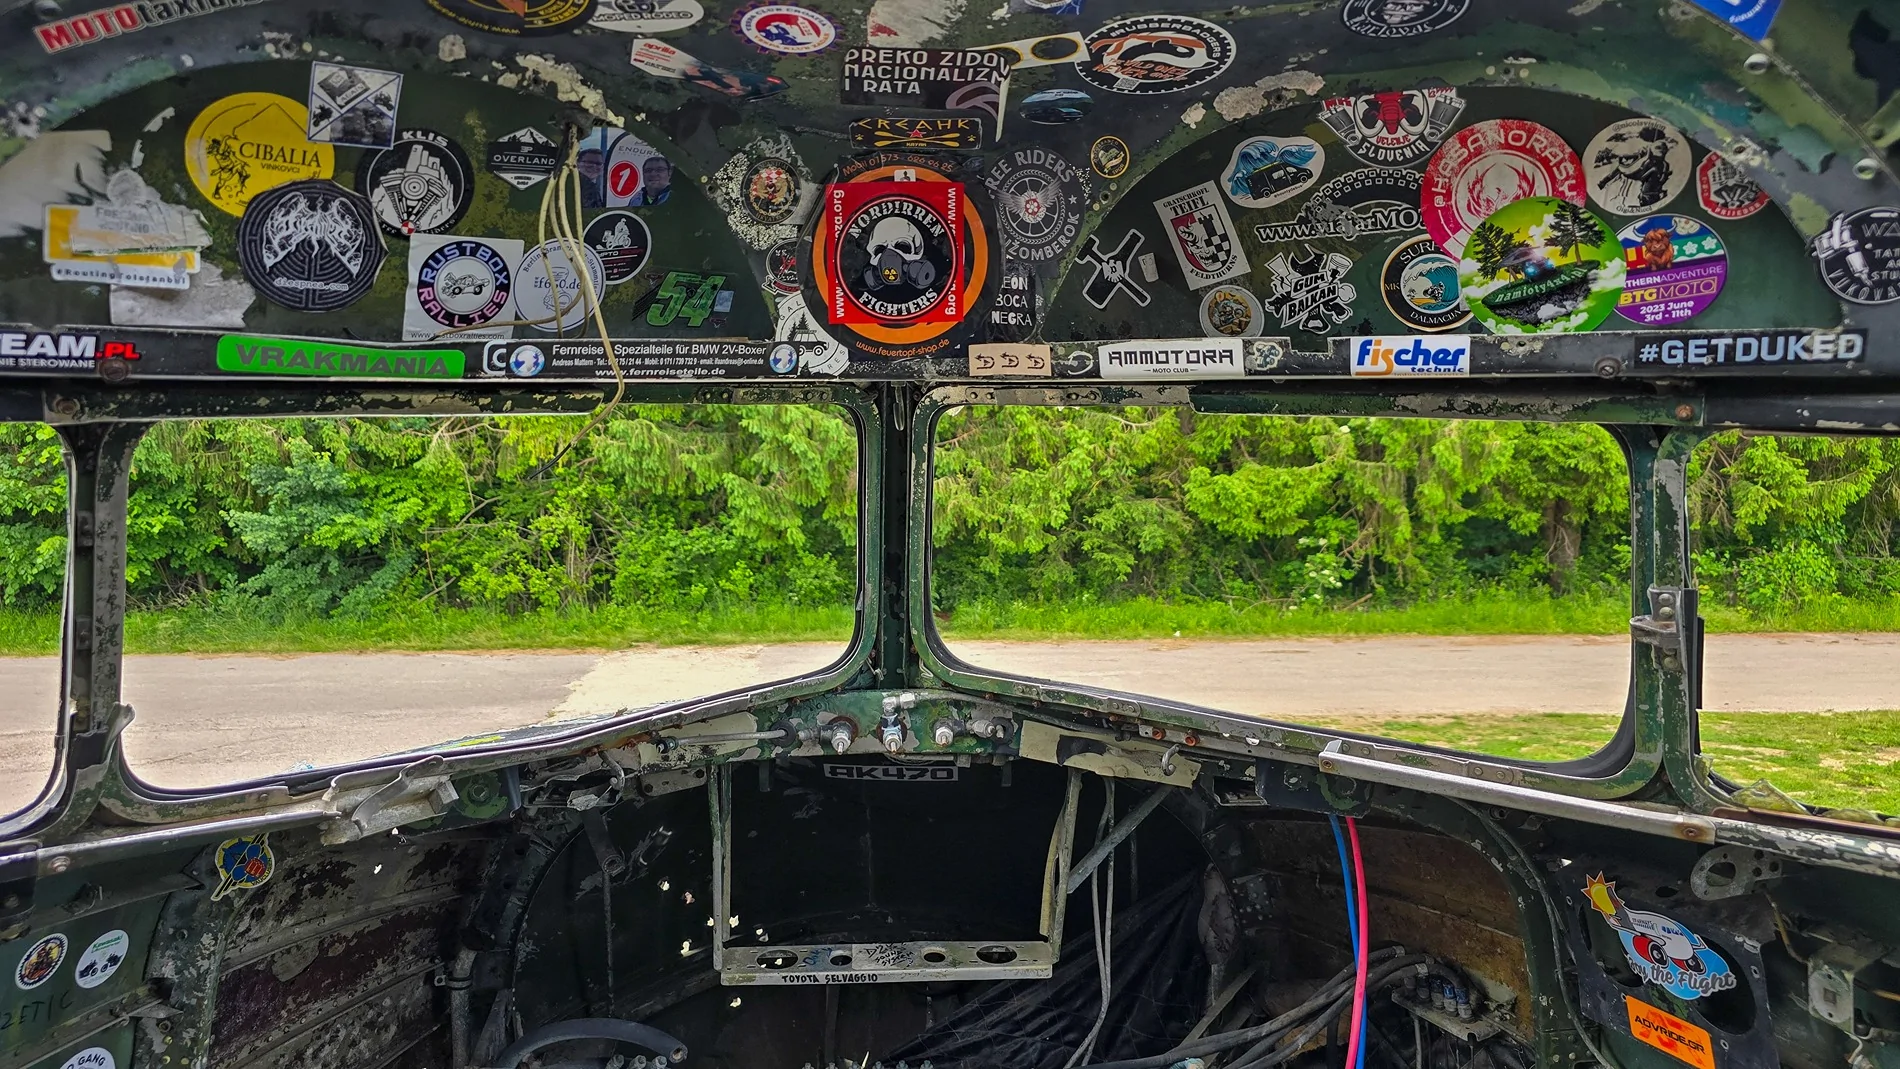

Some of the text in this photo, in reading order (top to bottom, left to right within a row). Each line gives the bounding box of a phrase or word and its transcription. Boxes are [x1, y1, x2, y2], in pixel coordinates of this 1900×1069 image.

[642, 10, 694, 20] RODEO
[643, 42, 676, 55] aprilia
[845, 49, 928, 65] PREKO
[845, 79, 921, 94] I RATA
[402, 131, 449, 147] KLIS
[1376, 134, 1412, 145] VELENJE
[239, 142, 322, 168] CIBALIA
[493, 154, 556, 166] OVERLAND
[1357, 141, 1431, 163] SLOVENIA
[261, 163, 300, 173] VINKOVCI
[1014, 150, 1076, 183] RIDERS
[1170, 196, 1210, 216] TEIFL
[848, 201, 945, 239] NORDIRREN
[421, 243, 508, 286] RUSTBOX
[522, 253, 542, 273] Berlin
[1190, 254, 1238, 279] FELDTHURNS
[274, 277, 349, 291] diespnea.com
[538, 277, 584, 290] f60.de
[1293, 273, 1326, 293] GUM
[1495, 267, 1588, 303] namioty4x4.pl
[646, 271, 727, 327] 54
[859, 288, 939, 316] FIGHTERS
[1287, 285, 1337, 320] BALKAN
[418, 287, 508, 328] RALLIES
[1640, 300, 1695, 315] 2023 June
[1644, 311, 1663, 322] 3rd
[1671, 309, 1692, 319] 11th
[991, 311, 1032, 326] NEGRA
[552, 344, 604, 355] Fernreise
[614, 344, 673, 357] Spezialteile
[675, 344, 690, 355] für
[691, 345, 720, 355] BMW
[722, 345, 767, 356] 2V-Boxer
[855, 338, 950, 358] www.feuertopf-shop.de
[1639, 334, 1864, 365] #GETDUKED
[18, 358, 96, 369] STEROWANE
[235, 344, 450, 377] VRAKMANIA
[552, 358, 574, 367] Andreas
[1108, 350, 1235, 365] AMMOTORA
[1355, 338, 1466, 376] fischer
[1411, 365, 1465, 373] technic
[829, 765, 954, 780] AK470
[782, 973, 878, 985] TOYOTA SELVAGGIO
[1650, 964, 1675, 984] the
[1678, 972, 1736, 995] Flight
[1634, 1014, 1706, 1055] ADVRIDE.GR
[78, 1053, 106, 1067] GANG
